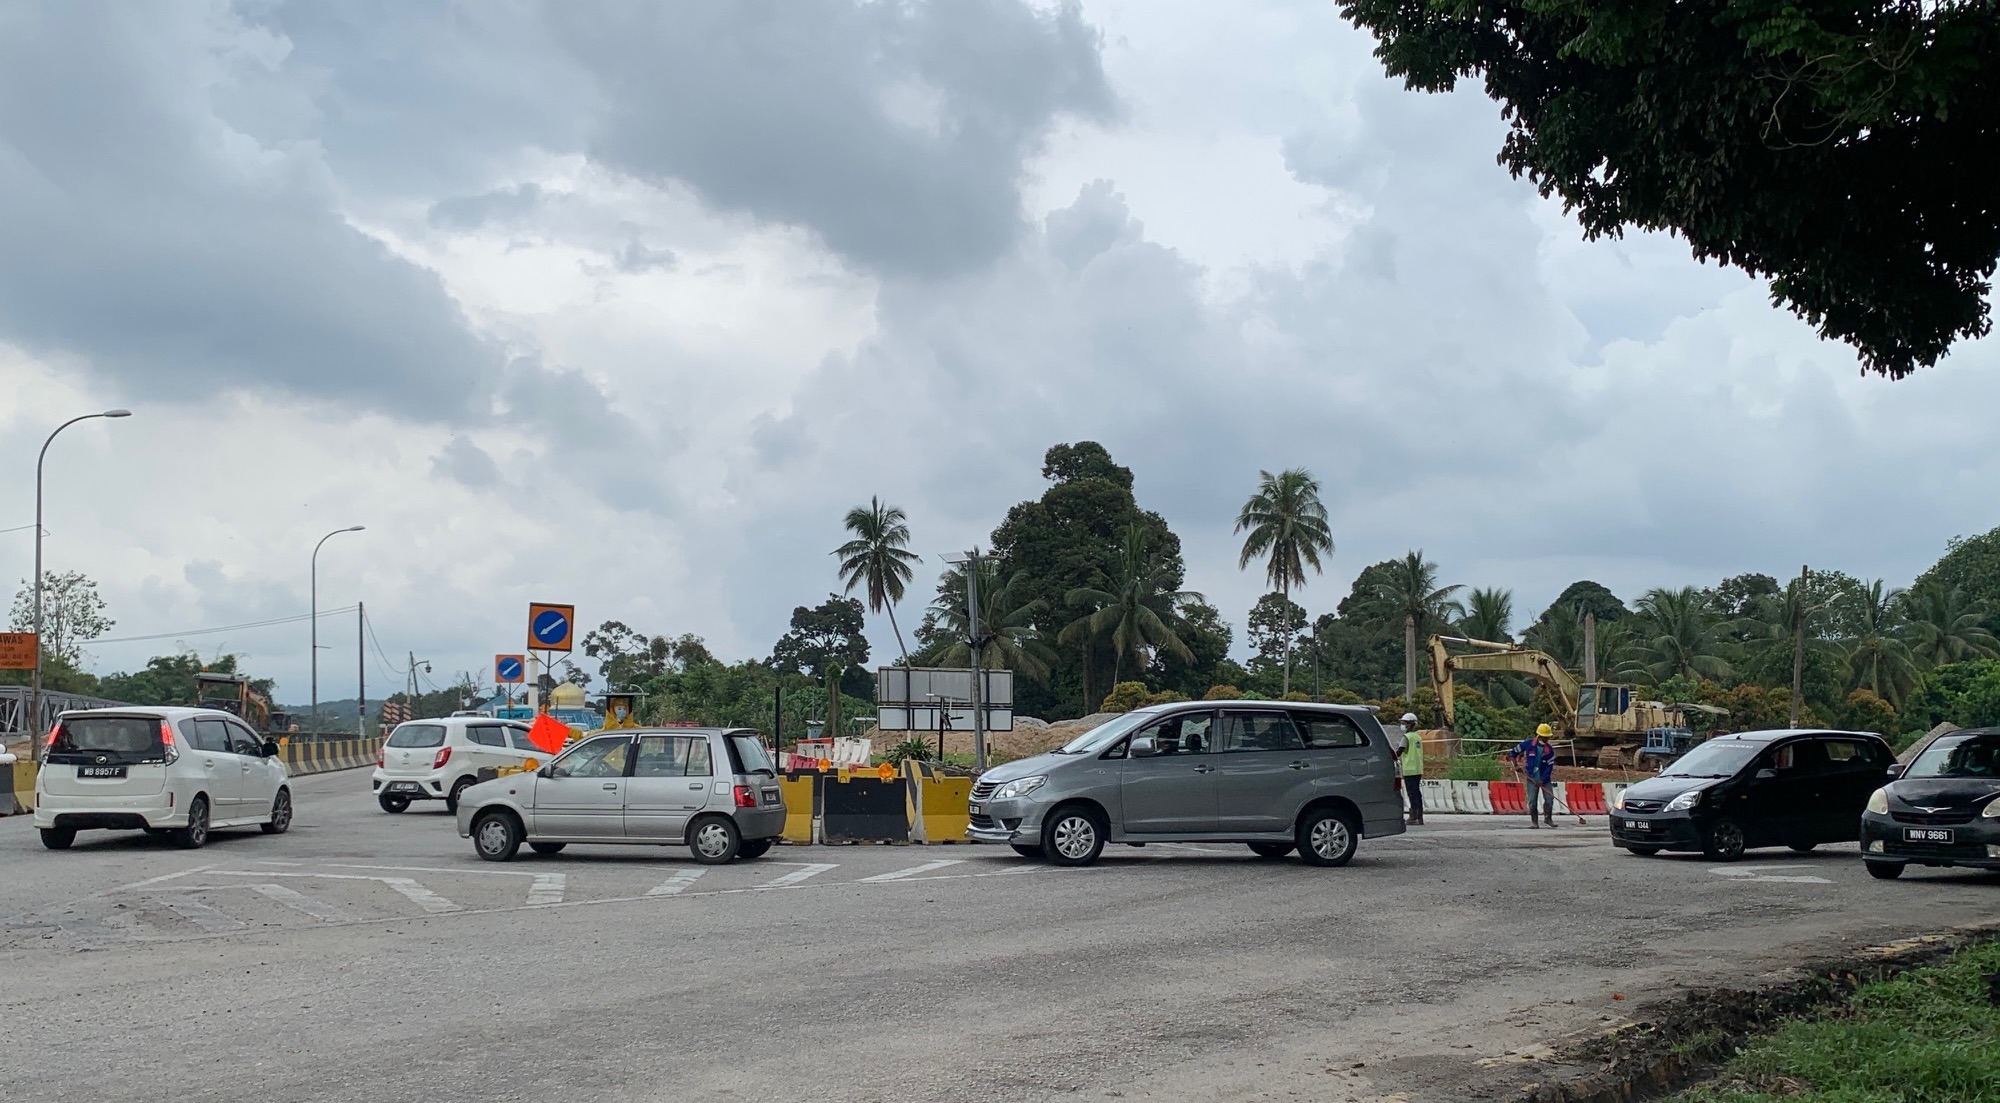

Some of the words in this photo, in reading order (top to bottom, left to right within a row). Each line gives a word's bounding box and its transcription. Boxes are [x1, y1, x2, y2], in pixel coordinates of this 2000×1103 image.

[84, 767, 94, 776] WB
[115, 767, 120, 775] F
[1910, 830, 1926, 839] WNV
[1927, 831, 1947, 840] 9661
